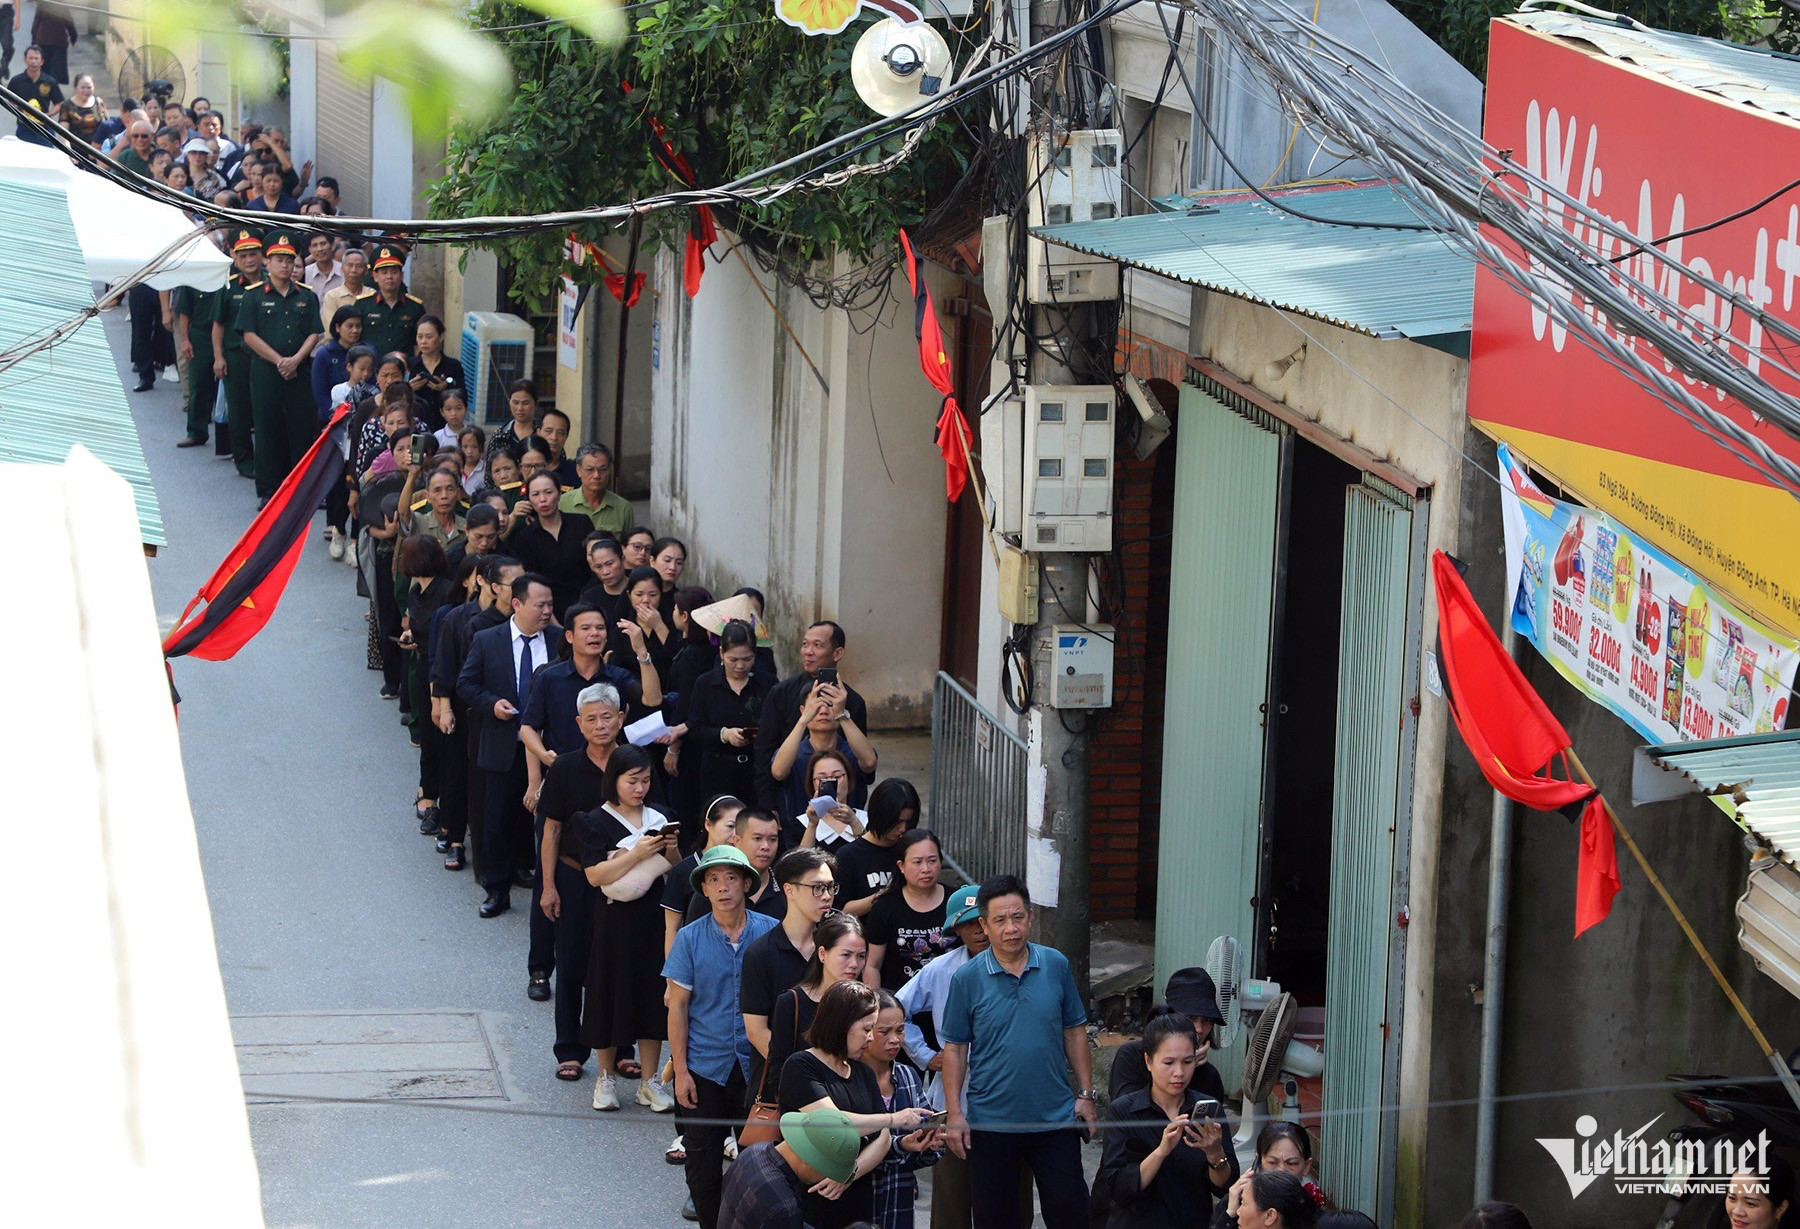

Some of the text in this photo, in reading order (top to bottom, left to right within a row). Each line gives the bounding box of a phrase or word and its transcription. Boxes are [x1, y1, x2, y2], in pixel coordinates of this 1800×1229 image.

[1599, 471, 1606, 489] 83
[1737, 560, 1753, 588] Đông
[1782, 588, 1790, 610] Hà
[1589, 625, 1622, 674] 32.000đ
